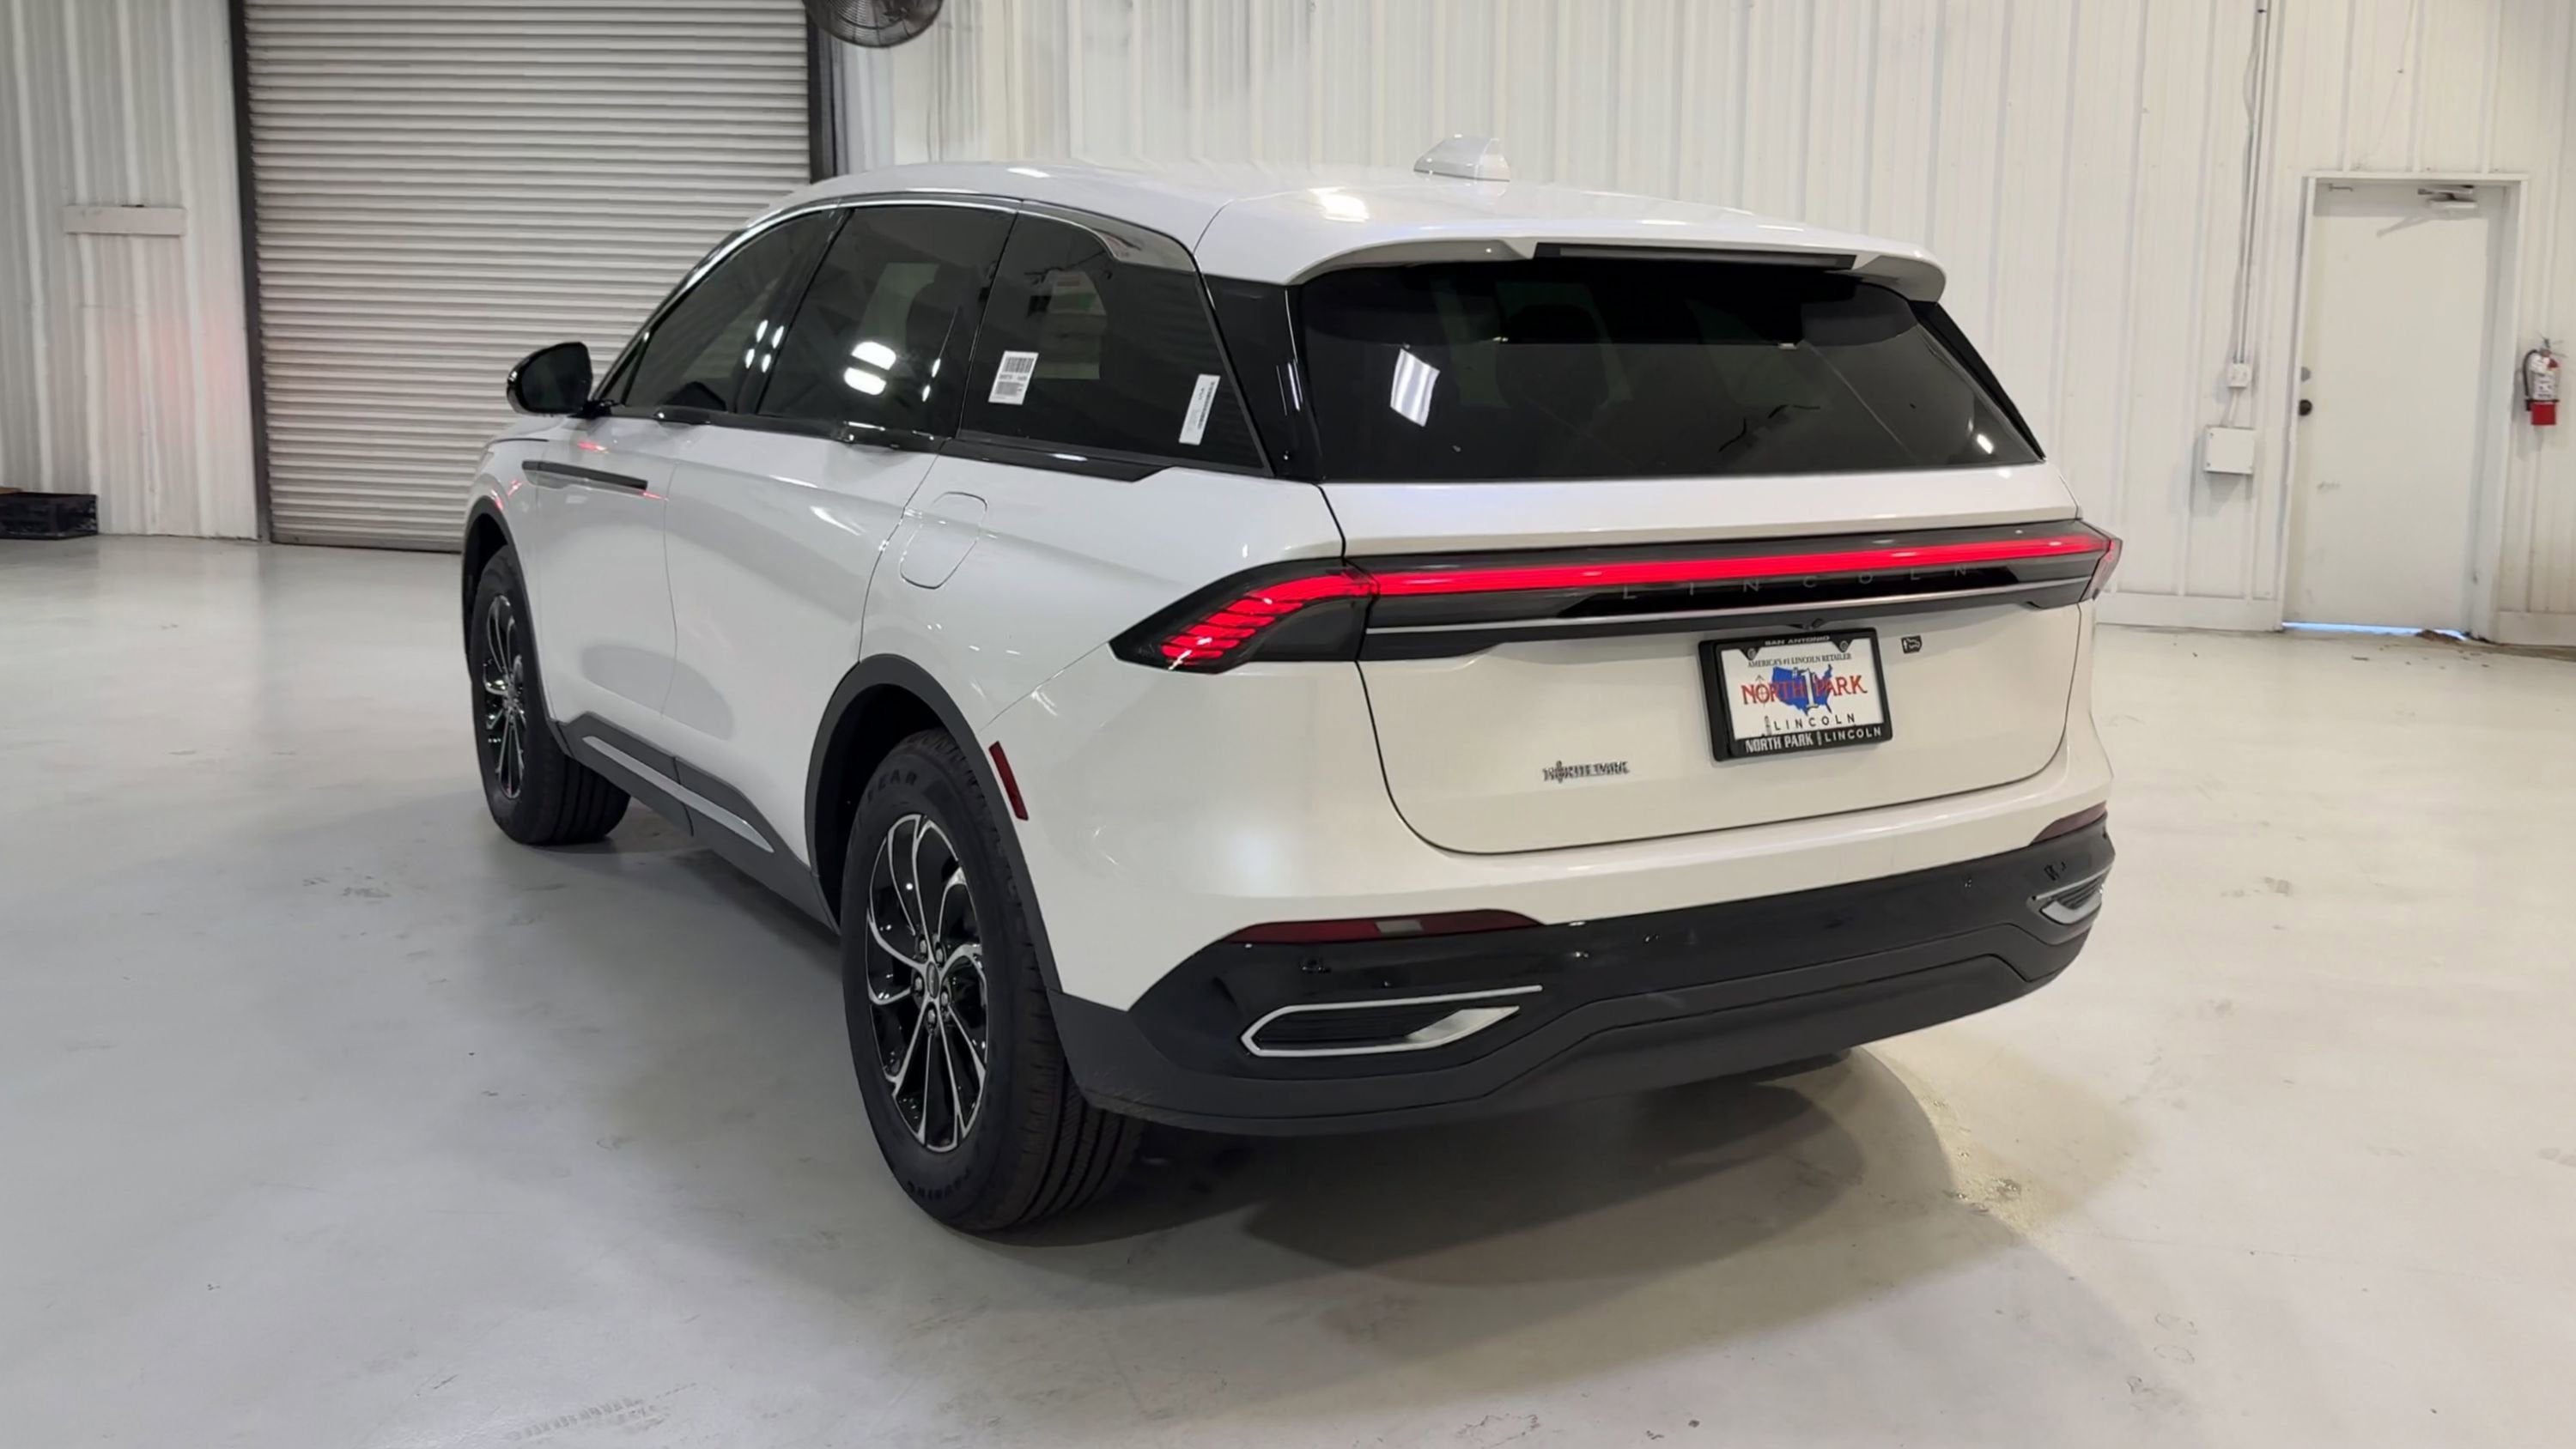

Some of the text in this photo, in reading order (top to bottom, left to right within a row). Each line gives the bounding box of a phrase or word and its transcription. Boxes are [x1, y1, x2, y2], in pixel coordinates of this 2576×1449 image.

[1623, 563, 1966, 599] LINCOLN
[1788, 635, 1831, 645] ANTONIO
[1791, 655, 1821, 664] LINCOLN
[1822, 652, 1852, 662] RETAILER
[1741, 675, 1868, 705] NORTH PARK
[1774, 713, 1856, 731] LINCOLN
[1745, 727, 1882, 753] NORTH PARK LINCOLN
